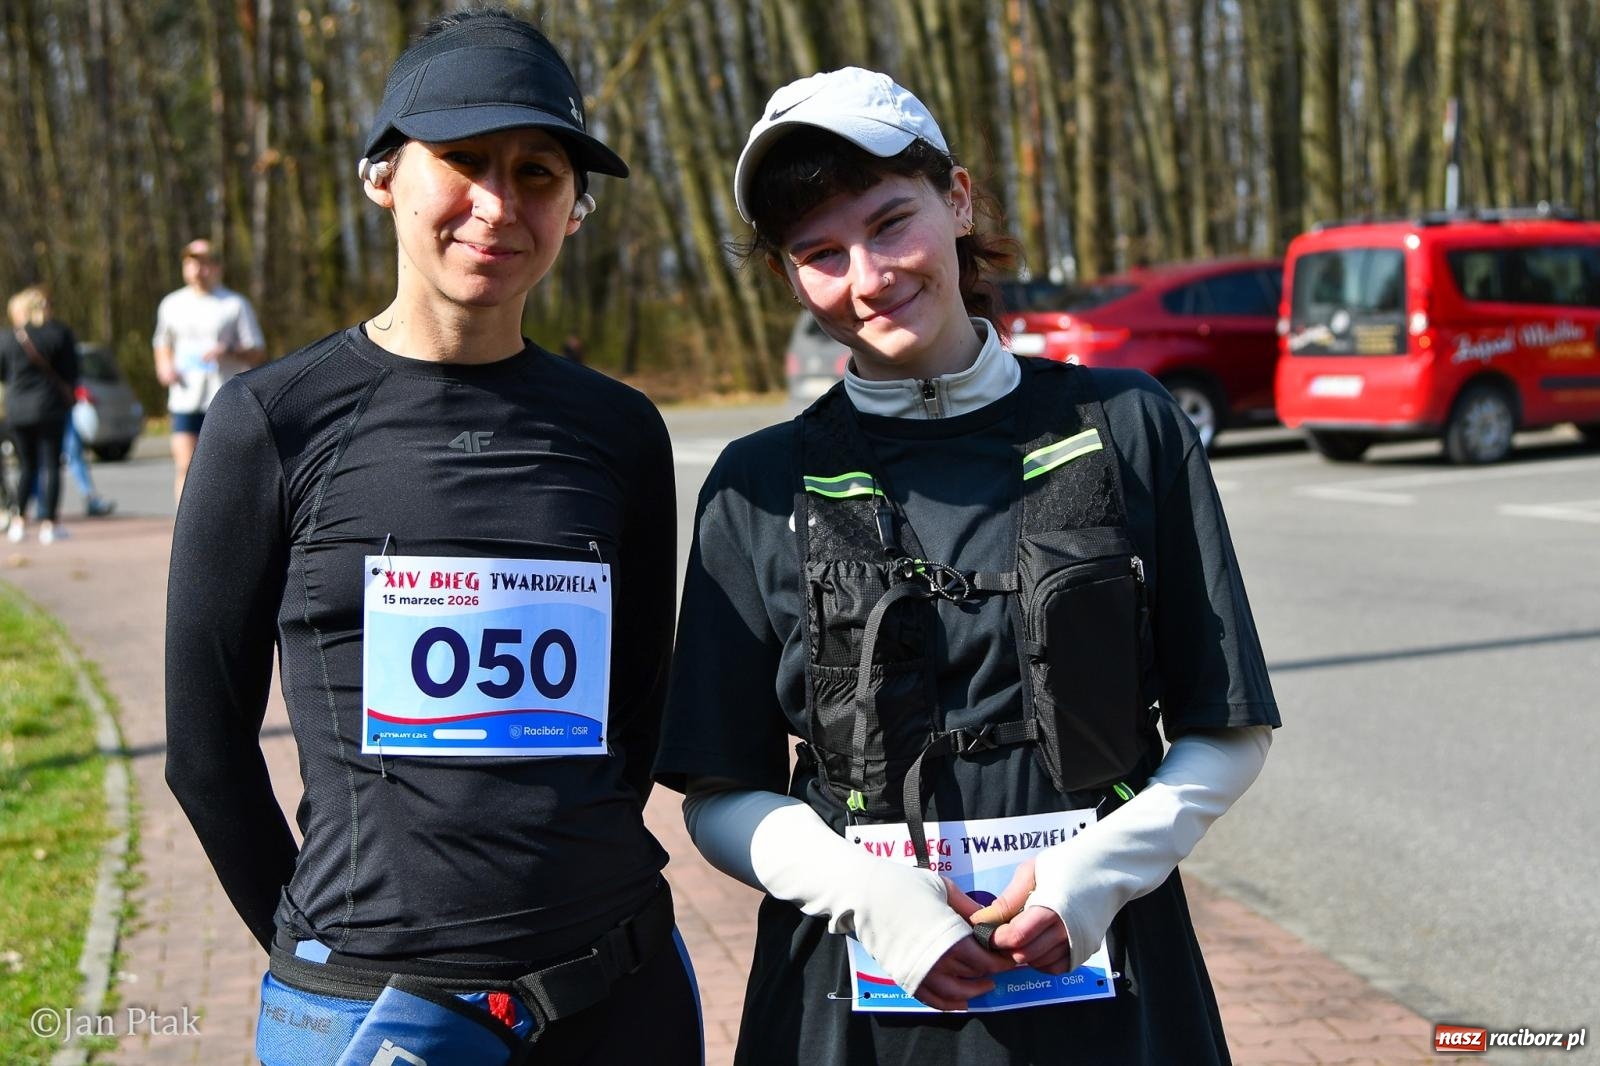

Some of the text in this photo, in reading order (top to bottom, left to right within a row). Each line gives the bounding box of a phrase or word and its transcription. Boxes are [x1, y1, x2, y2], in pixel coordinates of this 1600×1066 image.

[448, 430, 494, 452] 4F
[384, 570, 598, 594] XIV BIEG TWARDZIELA
[383, 595, 479, 606] 15 marzec 2026
[411, 626, 577, 699] 050
[523, 725, 565, 736] Racibórz
[904, 837, 952, 857] BEG
[929, 861, 952, 872] 026
[1007, 974, 1085, 993] Racibórz OSiR
